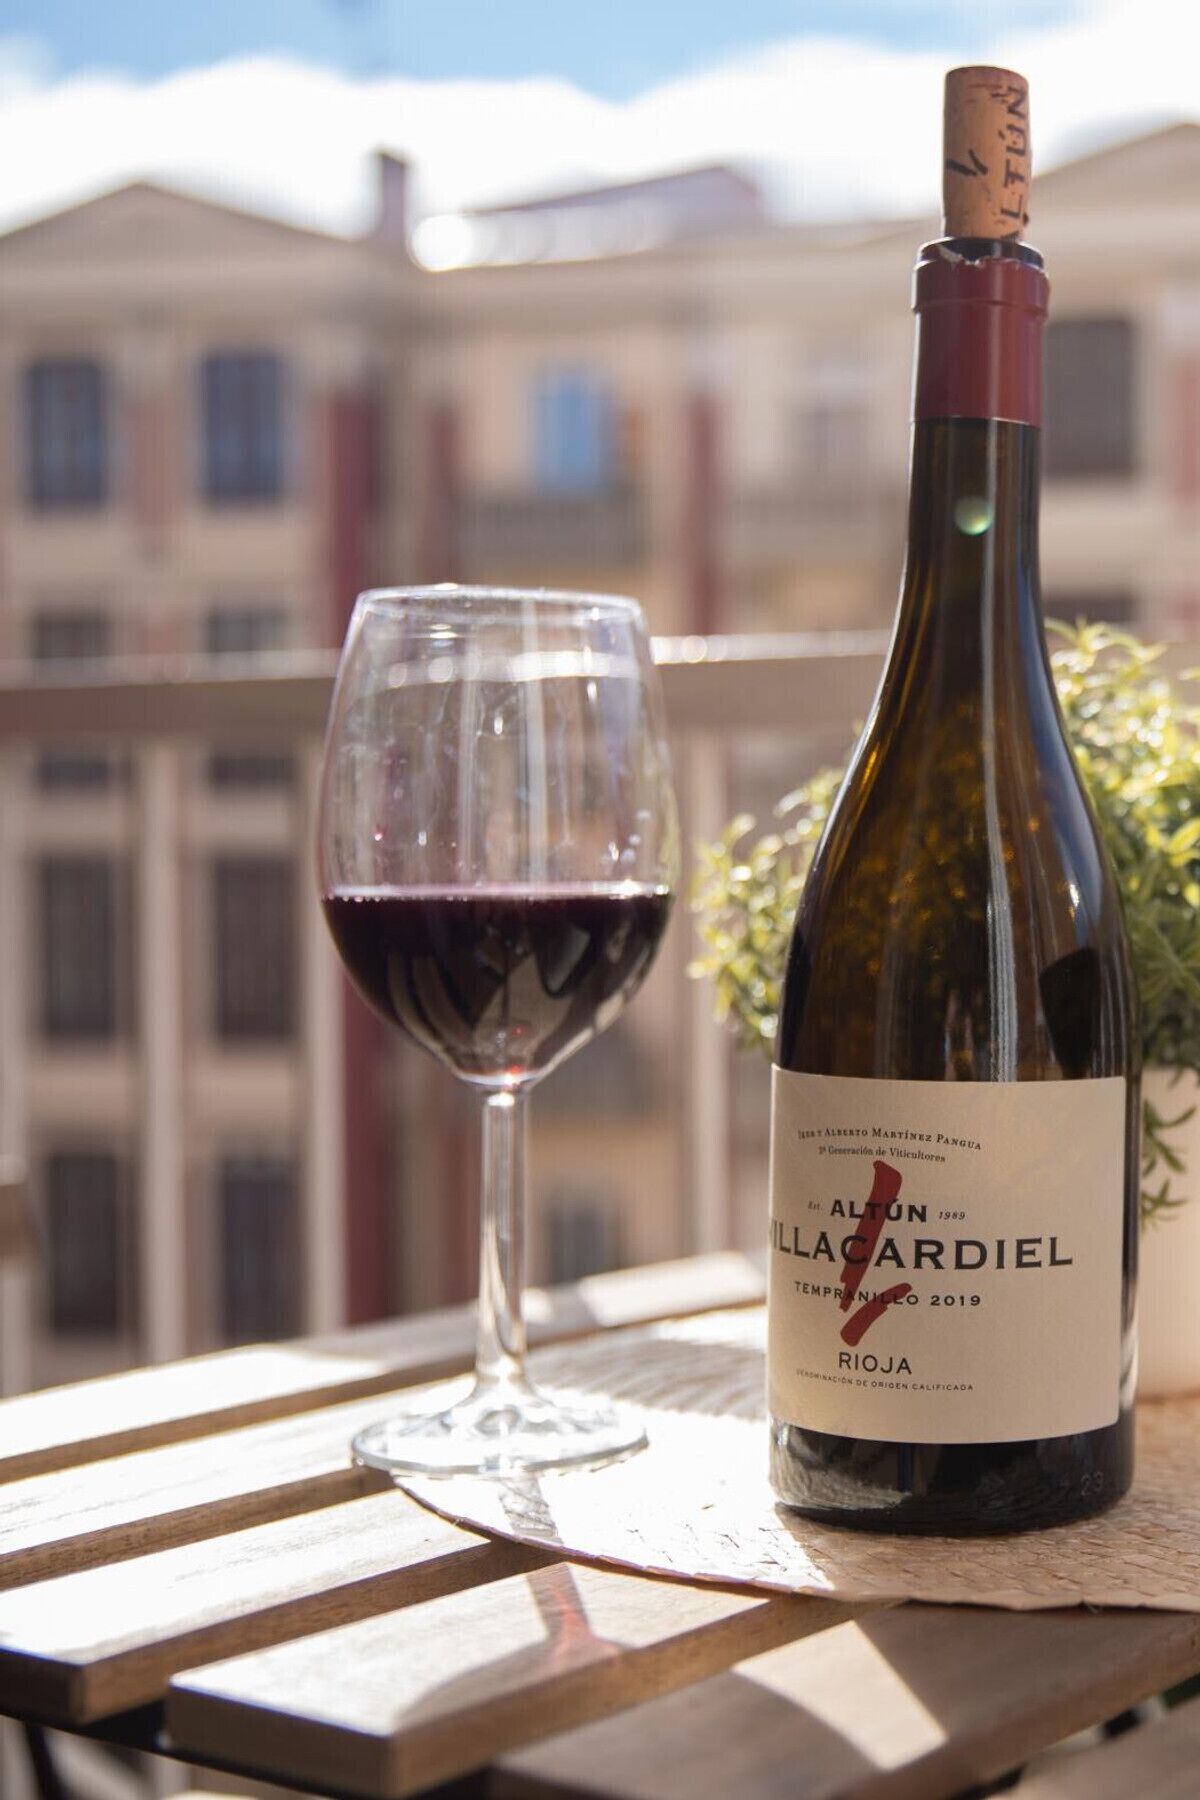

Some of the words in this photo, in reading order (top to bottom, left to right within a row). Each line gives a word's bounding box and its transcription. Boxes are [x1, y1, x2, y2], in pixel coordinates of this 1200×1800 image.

[824, 1128, 868, 1137] ALBERTO
[872, 1127, 932, 1142] MARTÍNEZ
[936, 1133, 981, 1150] PANGUA
[828, 1145, 873, 1156] Generación
[875, 1147, 886, 1156] de
[889, 1147, 946, 1163] Viticultores
[830, 1198, 928, 1223] ALTÚN
[938, 1211, 966, 1220] 1989
[795, 1281, 919, 1305] TEMPRANILLO
[930, 1295, 981, 1306] 2019
[838, 1351, 912, 1375] RIOJA
[856, 1380, 868, 1388] DE
[871, 1381, 909, 1390] ORIGEN
